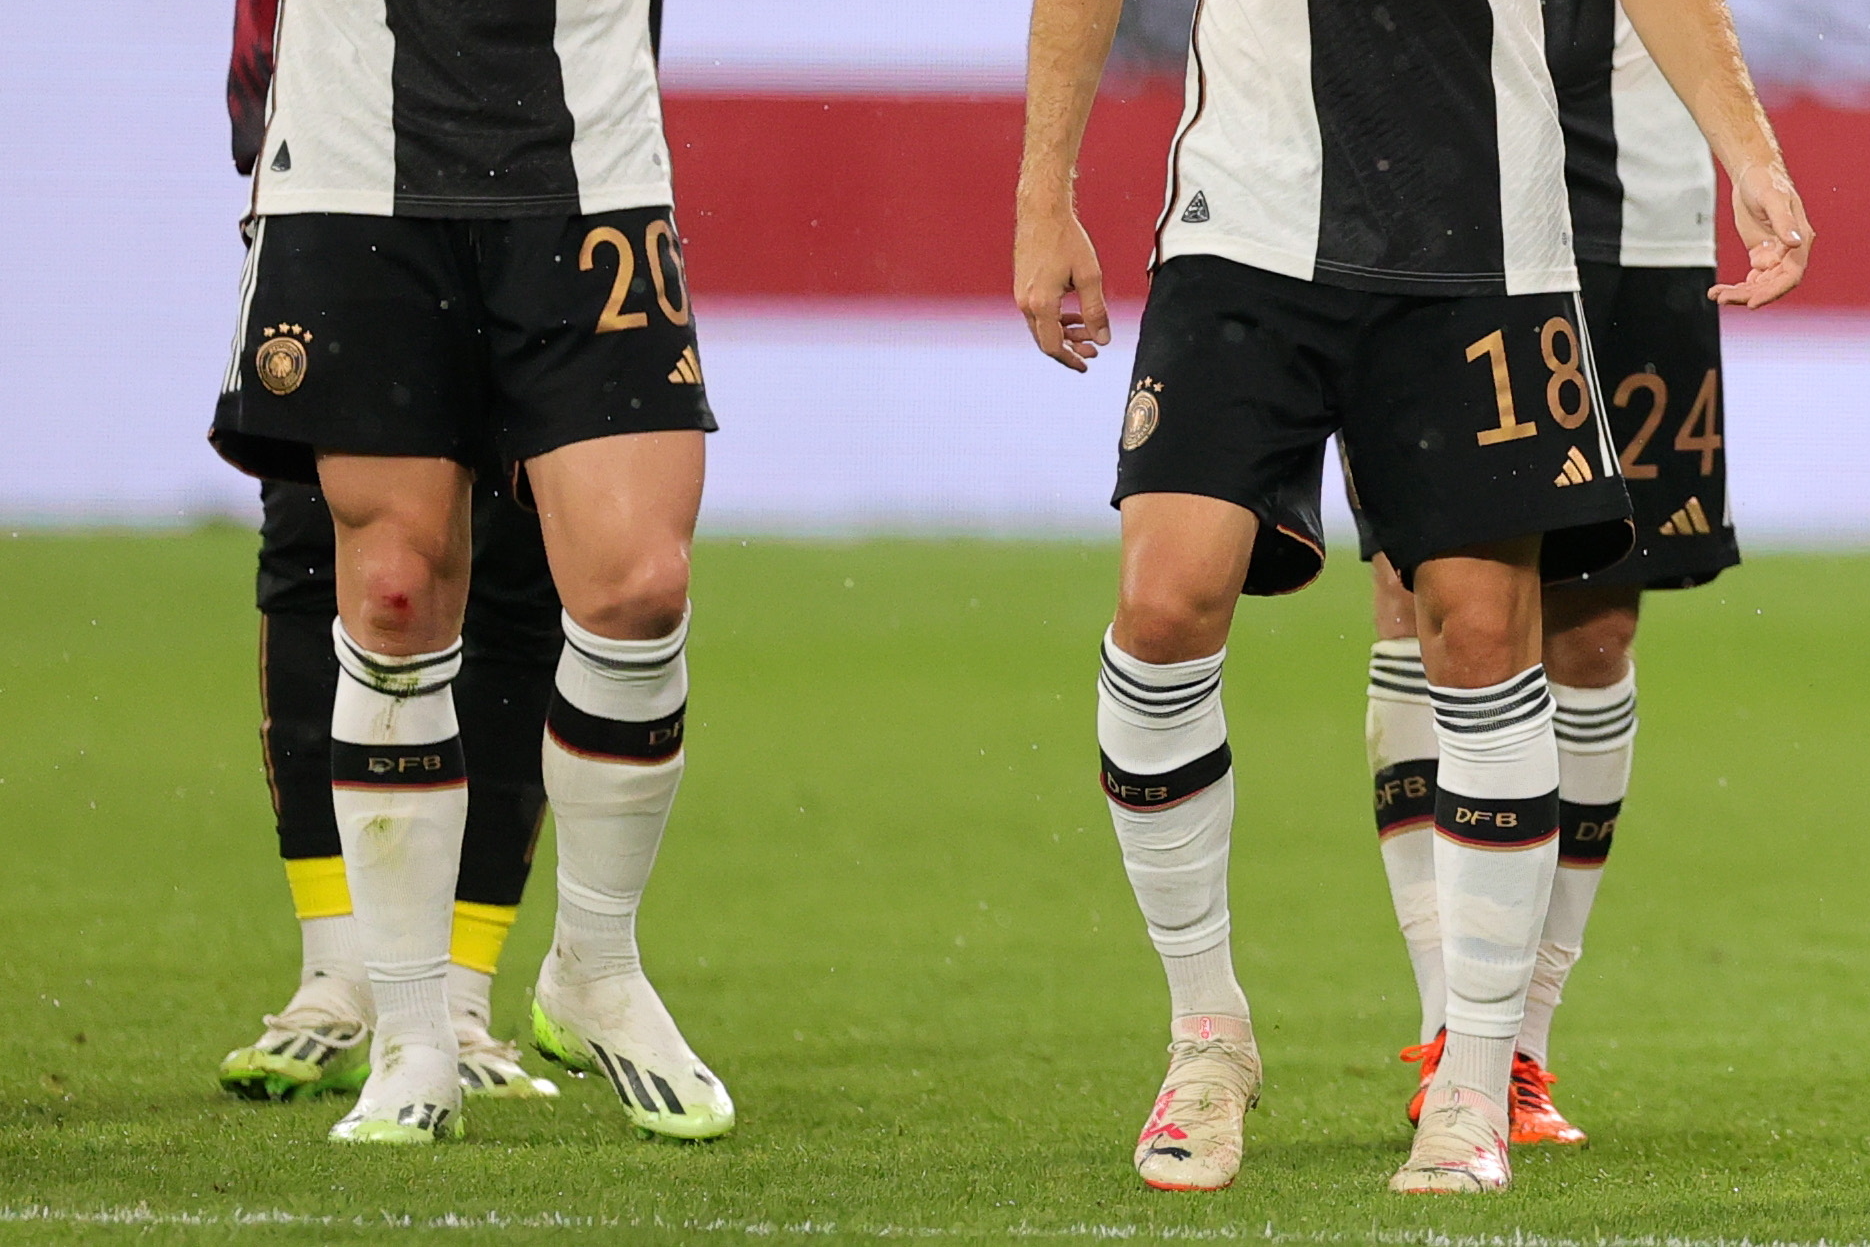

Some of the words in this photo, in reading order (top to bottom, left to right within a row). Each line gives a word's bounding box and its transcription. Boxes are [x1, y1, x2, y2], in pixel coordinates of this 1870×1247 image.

[579, 219, 689, 334] 20
[1465, 316, 1590, 446] 18
[1612, 368, 1722, 479] 24
[367, 755, 442, 773] DFB
[1107, 771, 1168, 801] DFB
[1455, 807, 1518, 828] DFB
[1575, 819, 1615, 841] DF
